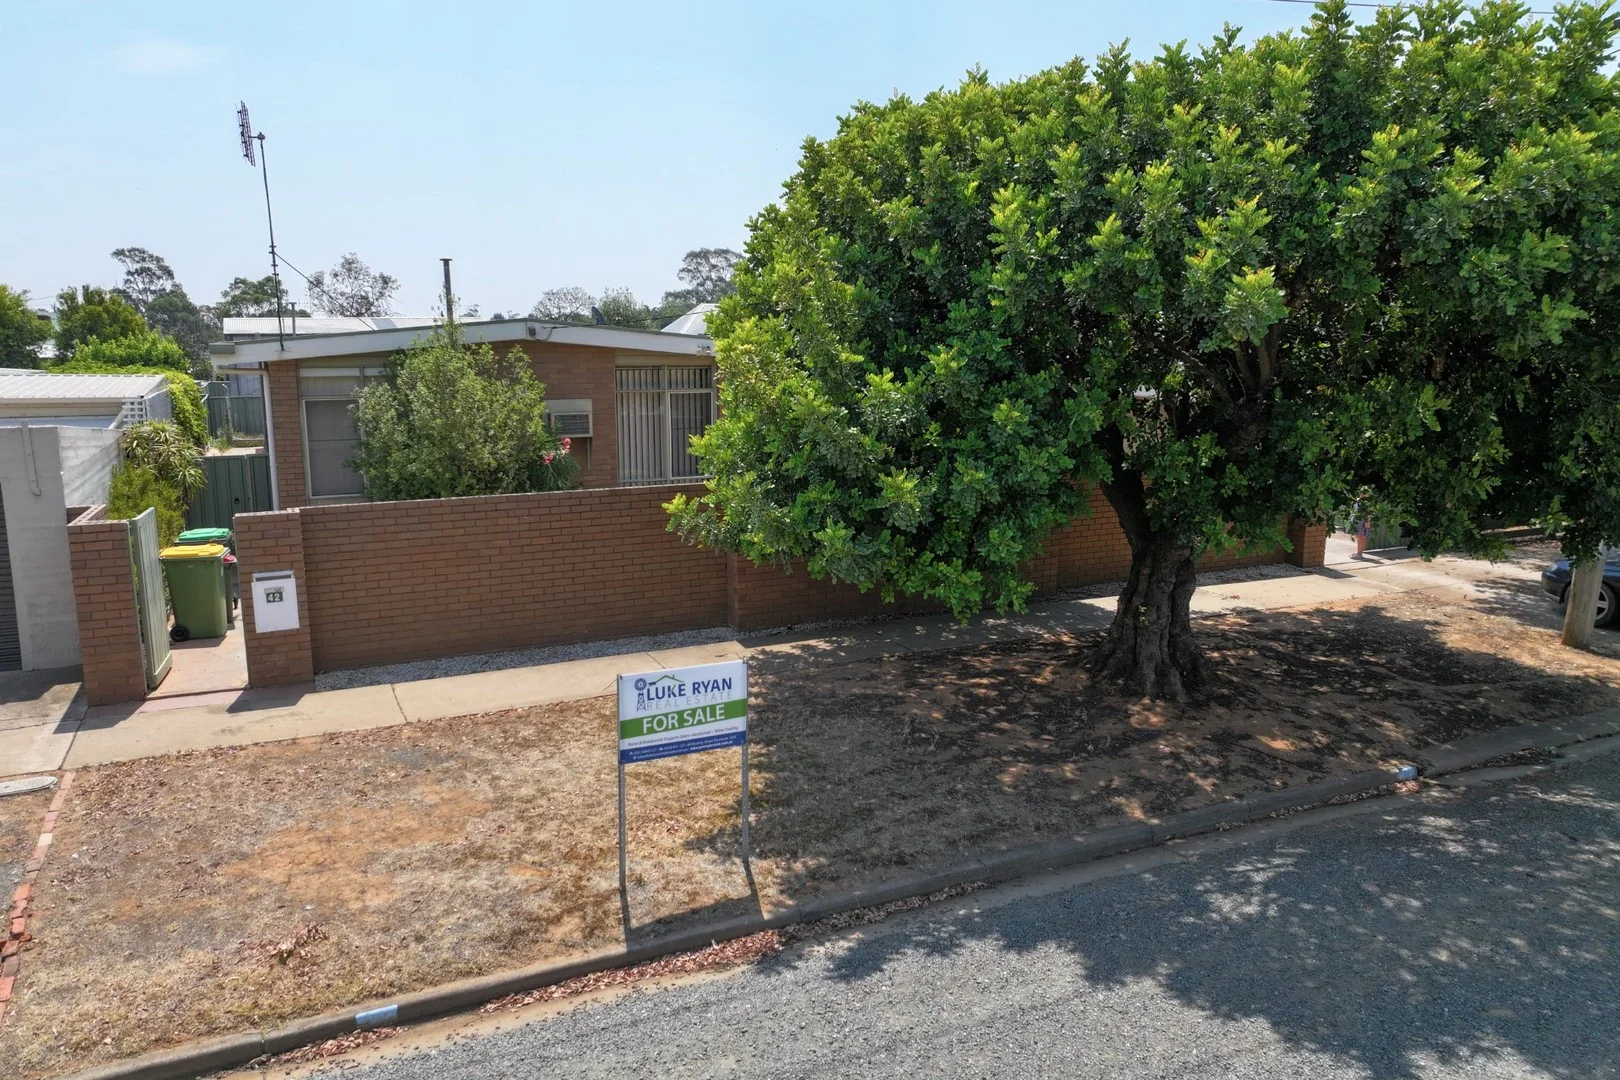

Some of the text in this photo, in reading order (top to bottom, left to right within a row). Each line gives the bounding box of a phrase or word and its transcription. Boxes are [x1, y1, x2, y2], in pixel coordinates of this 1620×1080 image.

[268, 593, 281, 602] 42
[647, 677, 732, 701] LUKE RYAN
[647, 691, 733, 711] REAL ESTATE
[643, 704, 725, 734] FOR SALE
